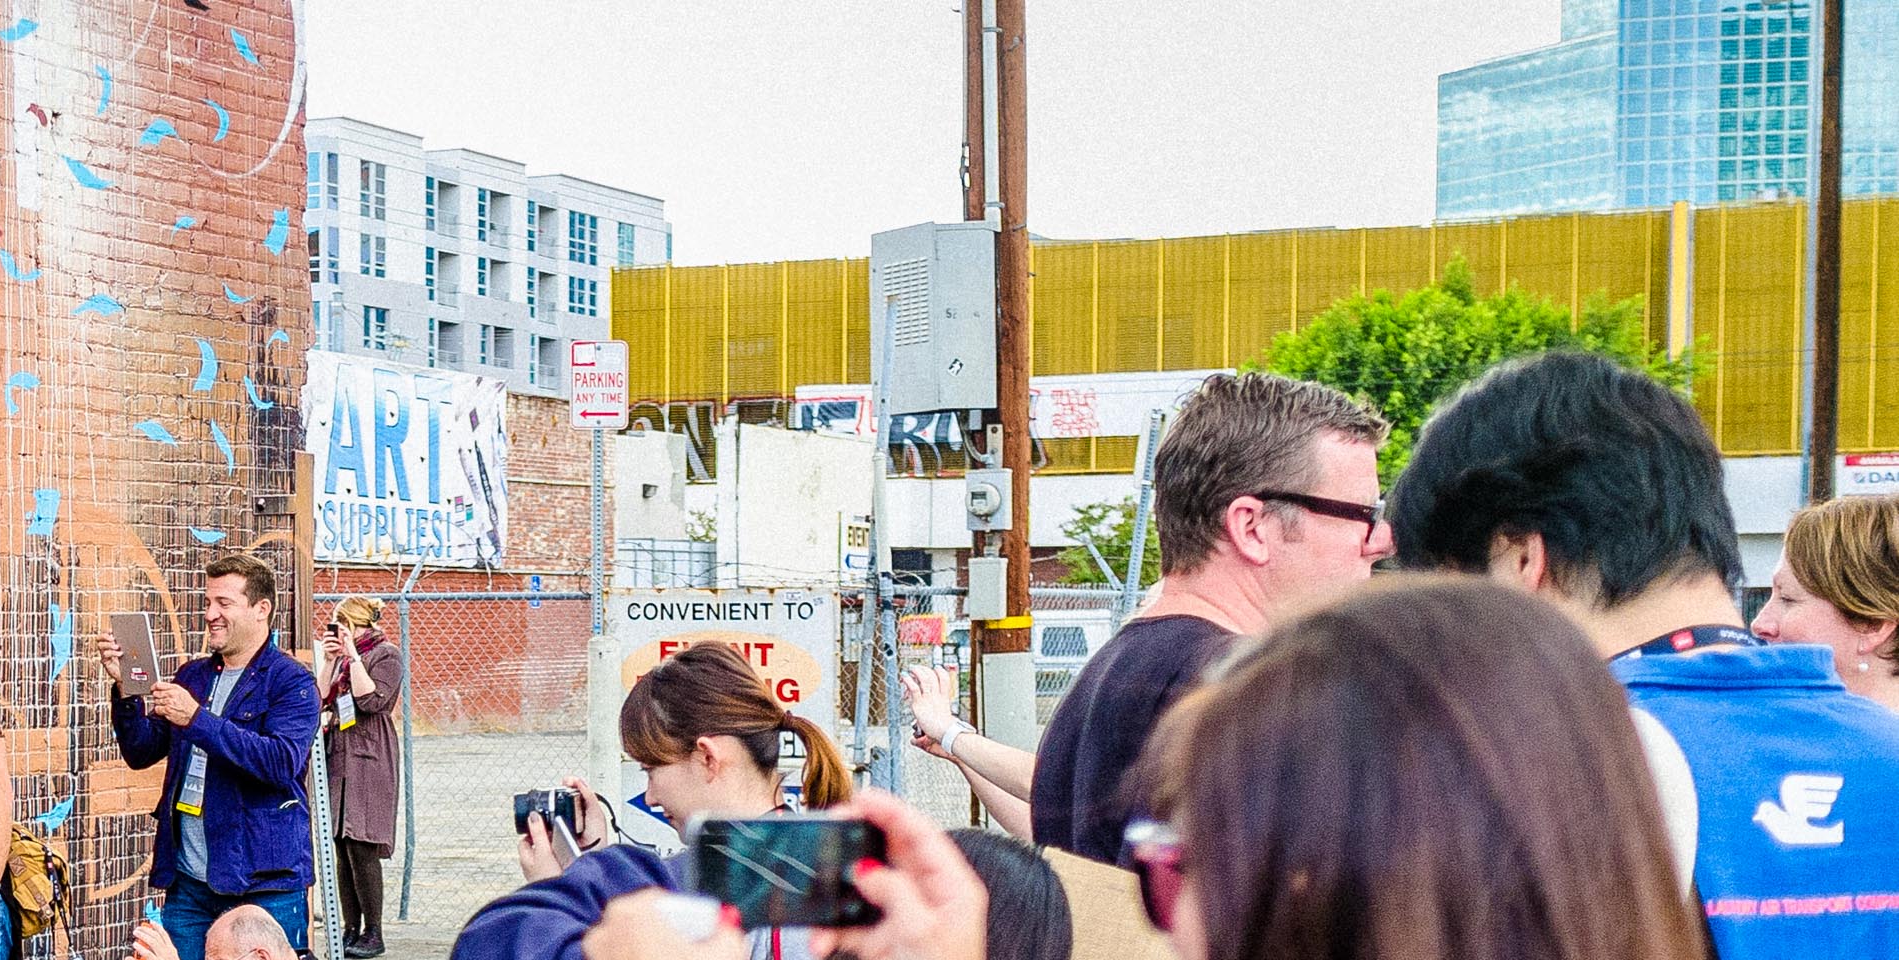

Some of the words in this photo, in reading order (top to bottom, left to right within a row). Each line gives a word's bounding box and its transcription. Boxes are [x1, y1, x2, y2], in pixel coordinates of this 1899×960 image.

[574, 372, 624, 388] PARKING
[575, 392, 596, 403] ANY
[601, 392, 623, 403] TIME
[324, 362, 453, 504] ART
[322, 499, 452, 558] SUPPLIES!
[627, 602, 774, 621] CONVENIENT
[783, 602, 814, 620] TO
